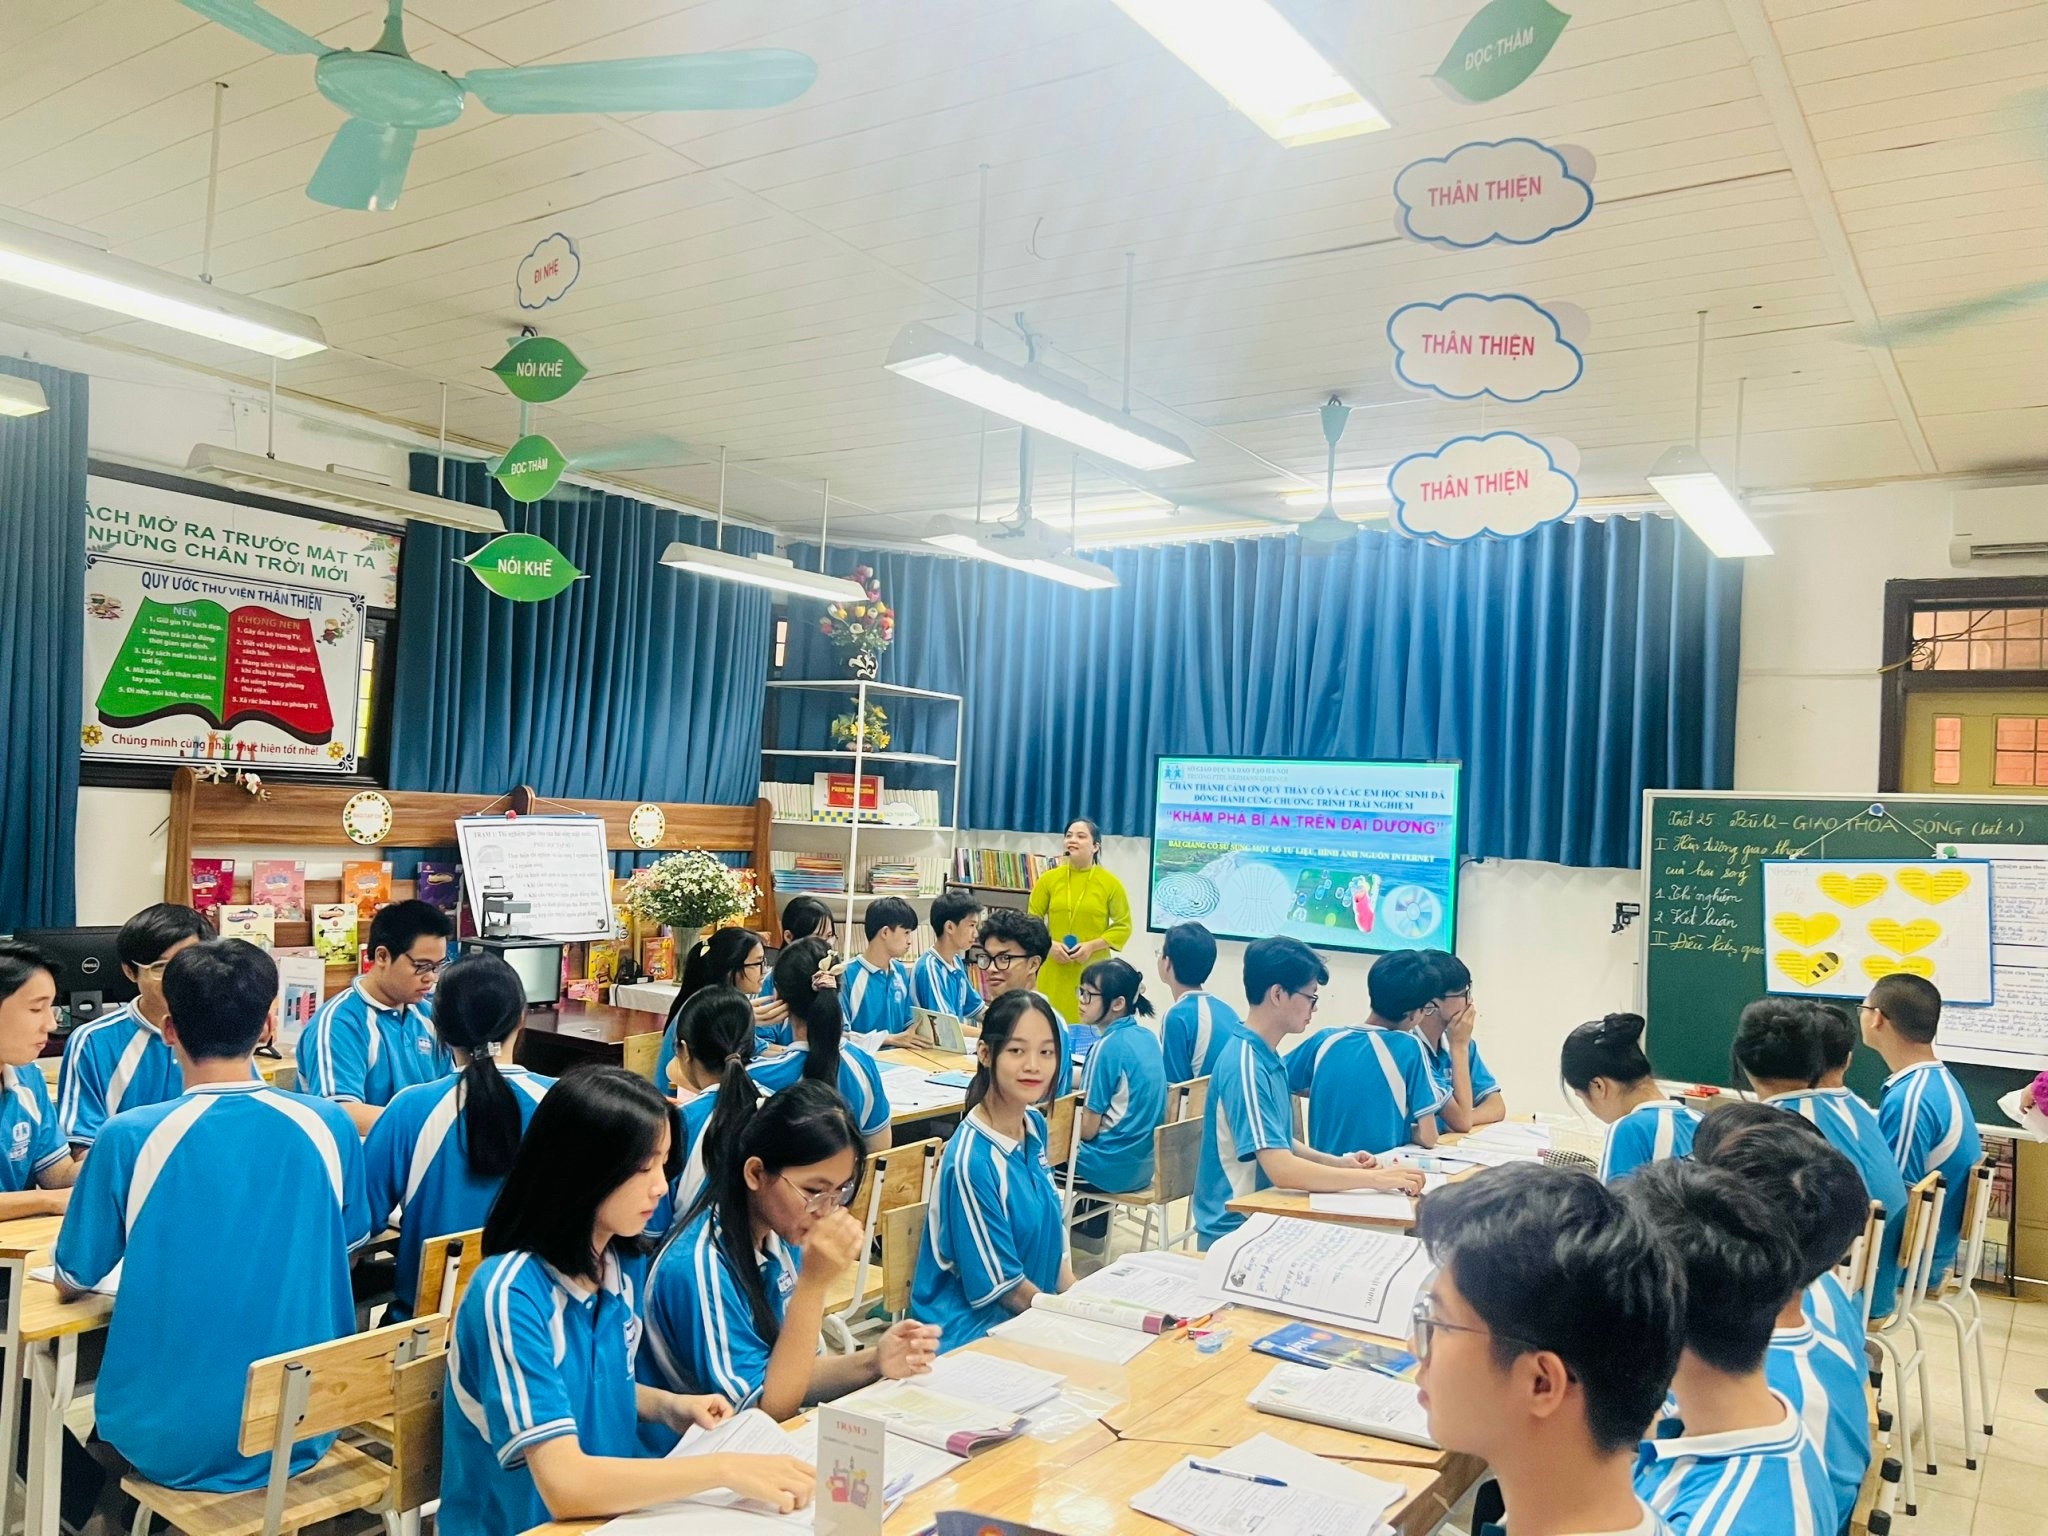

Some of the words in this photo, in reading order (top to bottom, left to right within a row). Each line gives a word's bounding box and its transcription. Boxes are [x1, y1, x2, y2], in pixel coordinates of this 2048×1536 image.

[1465, 44, 1493, 71] ĐỌC
[1428, 180, 1478, 207] THÂN
[1485, 174, 1541, 202] THIỆN
[534, 268, 541, 284] ĐI
[544, 258, 559, 279] NHẸ
[1422, 331, 1472, 355] THÂN
[1479, 334, 1535, 360] THIỆN
[516, 359, 536, 377] NÓI
[539, 359, 564, 377] KHẼ
[511, 463, 526, 477] ĐỌC
[1420, 474, 1468, 502] THÂN
[1474, 468, 1528, 496] THIỆN
[88, 525, 177, 553] NHỮNG
[185, 543, 248, 566] CHÂN
[255, 554, 304, 576] TRỜI
[311, 564, 348, 583] MỚI
[138, 514, 177, 533] MỞ
[184, 523, 215, 541] RA
[222, 529, 300, 555] TRƯỚC
[353, 554, 376, 570] TA
[498, 556, 520, 574] NÓI
[525, 559, 553, 577] KHẼ
[142, 571, 169, 590] QUY
[172, 576, 199, 592] ƯỚC
[202, 582, 228, 594] THƯ
[229, 585, 255, 600] VIỆN
[258, 588, 289, 606] THÂN
[291, 592, 322, 614] THIỆN
[112, 734, 147, 748] Chúng
[180, 738, 205, 751] cùng
[260, 743, 280, 755] hiện
[283, 745, 296, 755] tốt
[1342, 788, 1361, 797] CÁC
[1364, 789, 1379, 797] EM
[1381, 789, 1403, 799] HỌC
[1405, 790, 1428, 799] SINH
[1218, 811, 1246, 825] PHÁ
[1251, 813, 1265, 826] BÍ
[1296, 813, 1335, 830] TRÊN
[1341, 817, 1367, 835] ĐẠI
[1699, 812, 1717, 827] 25
[1793, 815, 1838, 831] GIAO
[1846, 817, 1898, 833] THOA
[1912, 812, 1966, 836] SÓNG
[1391, 853, 1435, 863] INTERNET
[1742, 844, 1768, 864] giao
[1665, 860, 1685, 875] của
[1689, 859, 1713, 877] hai
[1720, 865, 1751, 886] sóng
[1695, 888, 1742, 911] nghiệm
[1671, 908, 1695, 926] Kết
[1700, 904, 1738, 934] luận
